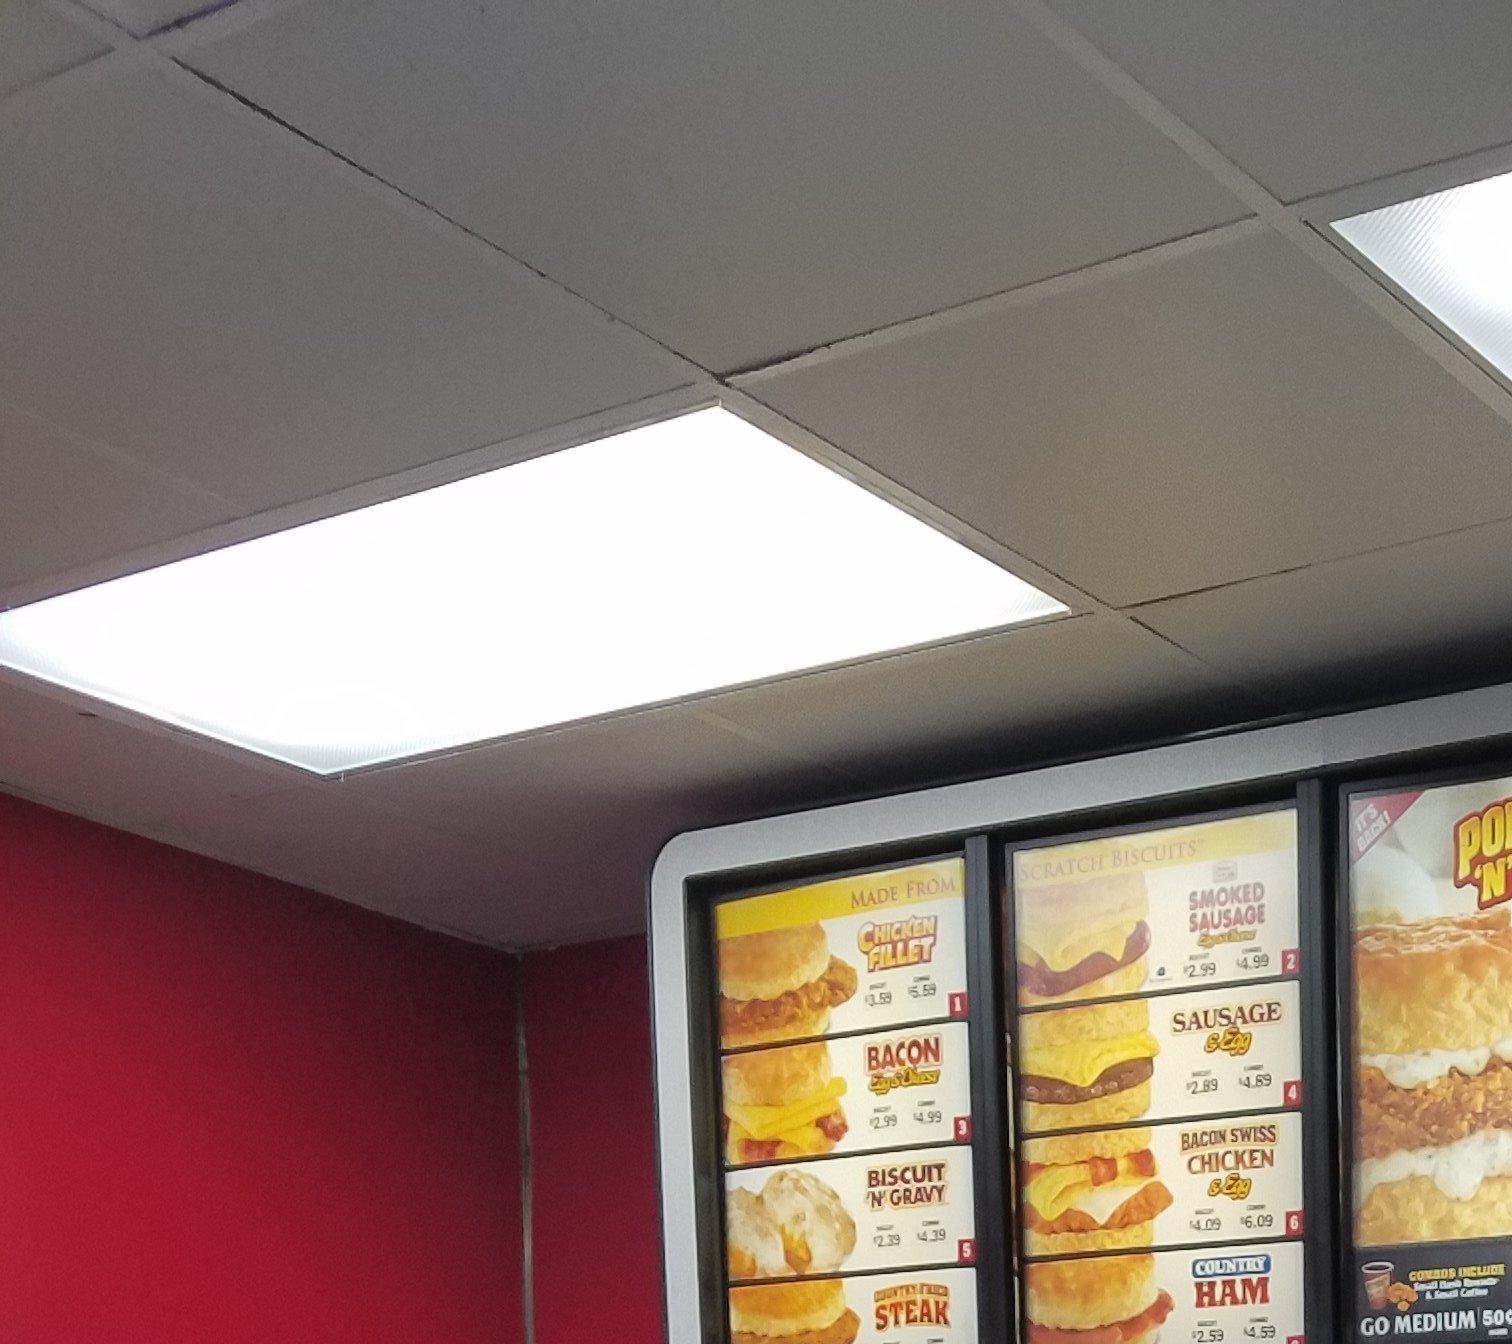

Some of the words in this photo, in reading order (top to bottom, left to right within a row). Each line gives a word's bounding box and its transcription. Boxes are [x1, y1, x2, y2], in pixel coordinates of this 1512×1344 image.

[1019, 857, 1104, 881] SCRATCH
[851, 887, 898, 908] MADE
[907, 878, 955, 898] FROM
[1189, 882, 1265, 911] SMOKED
[1189, 904, 1265, 932] SAUSAGE
[868, 936, 934, 972] FILLET
[1285, 953, 1296, 970] 2
[953, 996, 961, 1011] 1
[1173, 1002, 1282, 1033] SAUSAGE
[867, 1037, 940, 1071] BACON
[1288, 1084, 1297, 1100] 4
[957, 1119, 967, 1136] 3
[1181, 1129, 1227, 1151] BACON
[1231, 1124, 1276, 1143] SWISS
[1188, 1149, 1274, 1175] CHICKEN
[867, 1163, 945, 1188] BISCUIT
[890, 1184, 945, 1206] GRAVY
[1290, 1215, 1299, 1230] 6
[962, 1242, 971, 1257] 5
[1195, 1256, 1266, 1276] COUNTRY
[1194, 1277, 1270, 1308] HAM
[875, 1299, 950, 1330] STEAK
[1361, 1316, 1390, 1336] GO
[1394, 1308, 1476, 1335] MEDIUM
